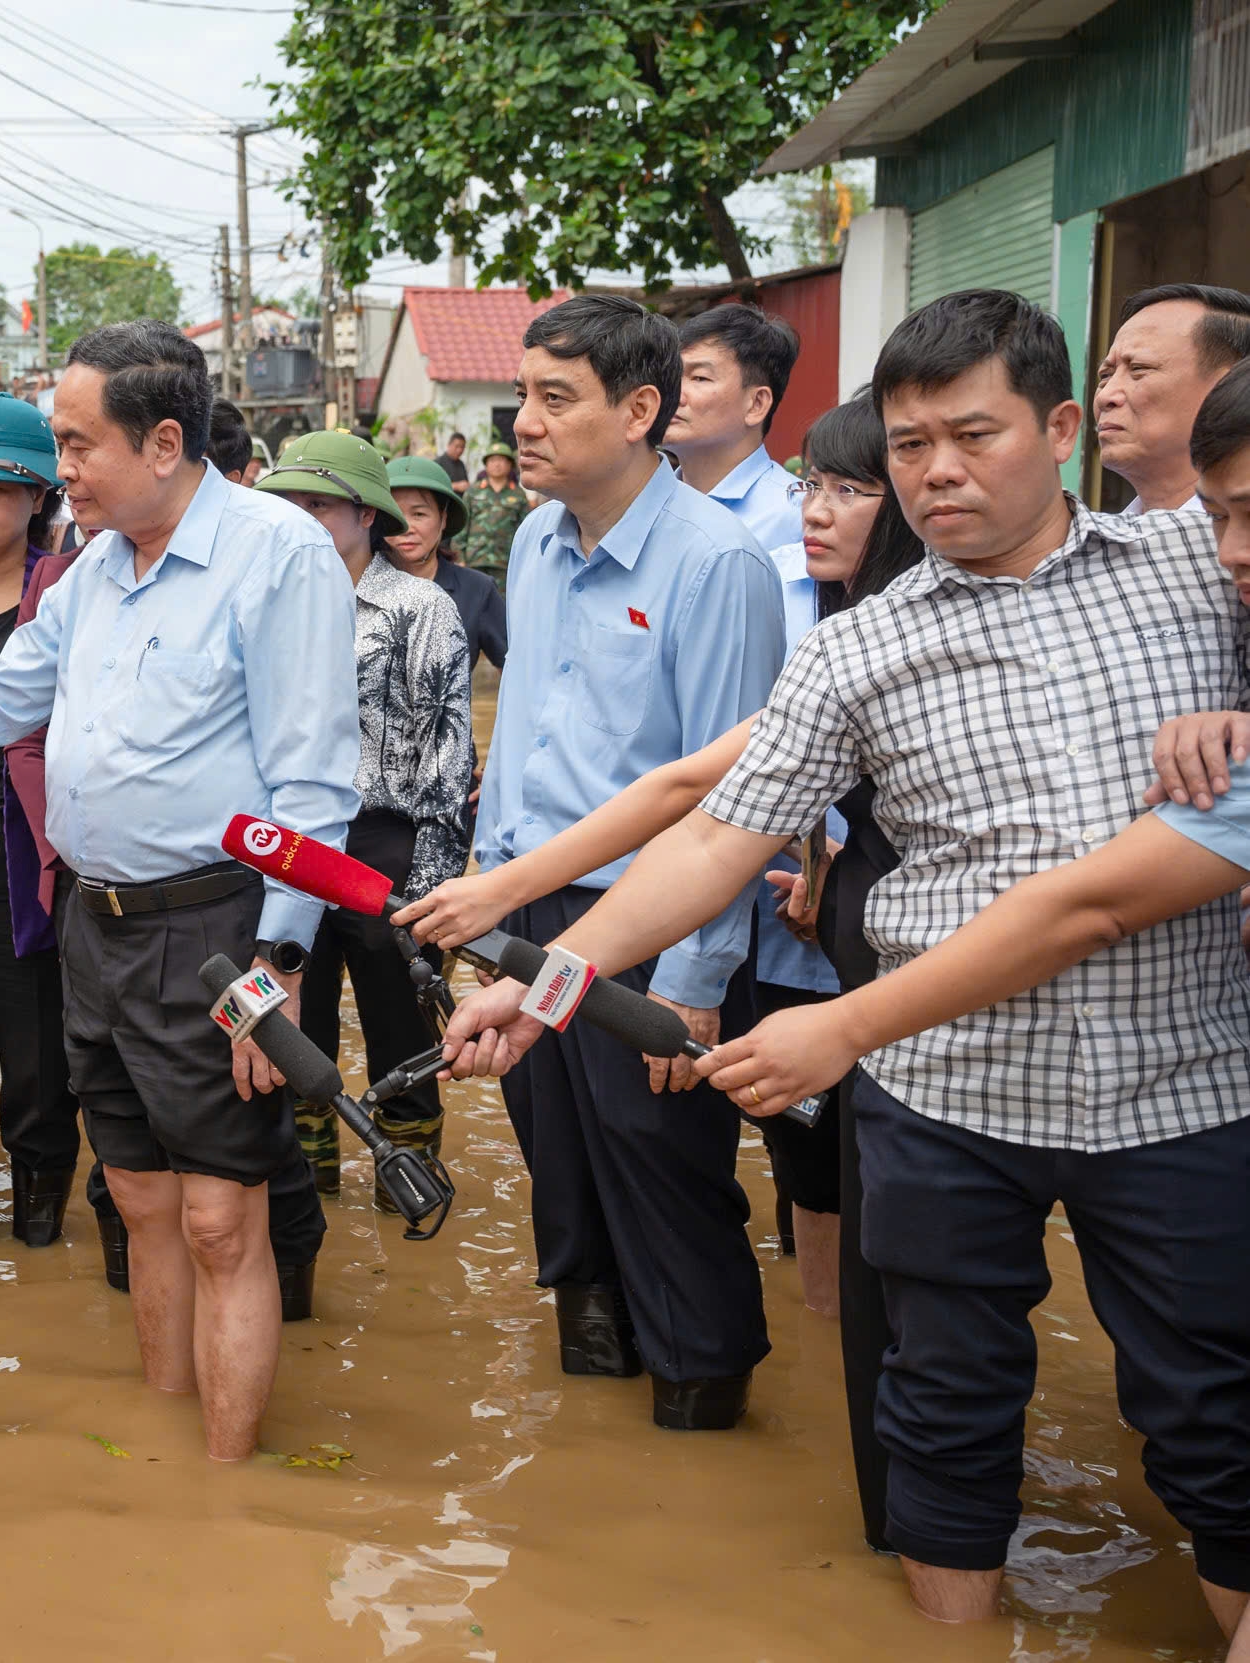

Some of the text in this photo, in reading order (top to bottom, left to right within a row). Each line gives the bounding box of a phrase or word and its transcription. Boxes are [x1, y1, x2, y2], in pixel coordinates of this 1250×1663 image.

[281, 846, 298, 871] QUỐC
[536, 989, 556, 1014] Nhân
[548, 974, 565, 992] Dân
